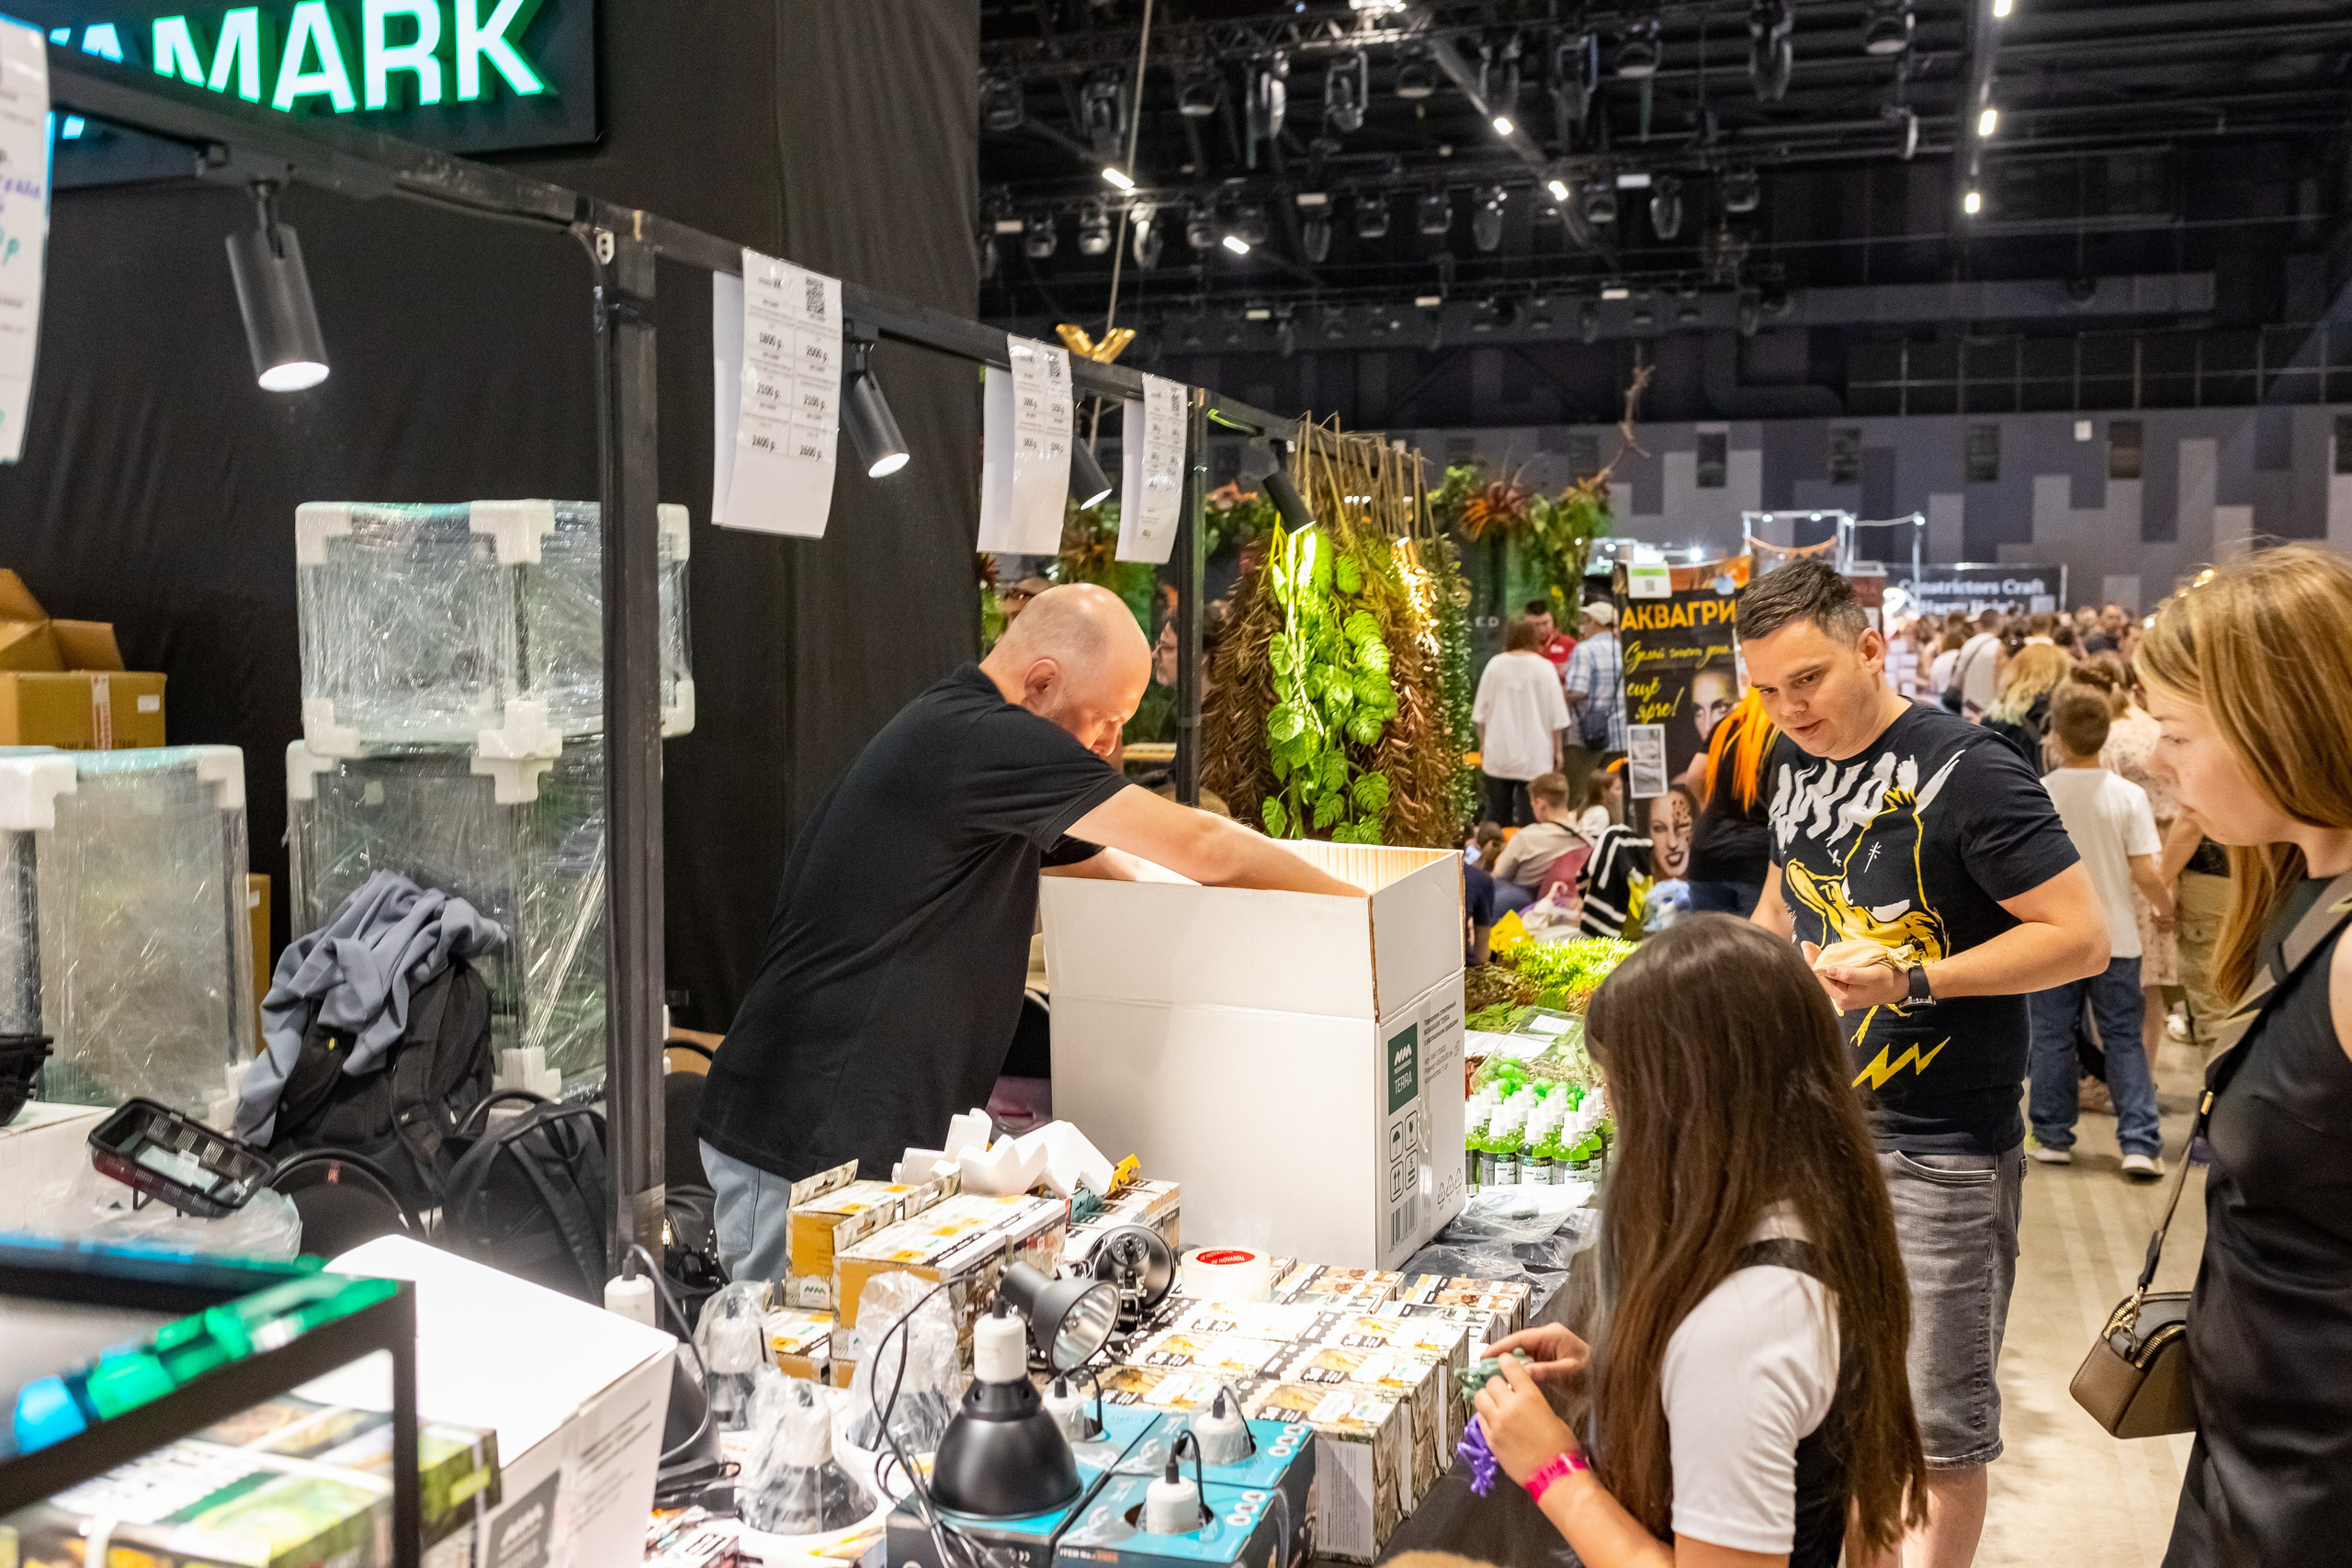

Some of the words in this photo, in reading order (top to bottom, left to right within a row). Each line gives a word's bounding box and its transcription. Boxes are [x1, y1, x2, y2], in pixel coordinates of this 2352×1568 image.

[2001, 578, 2045, 595] Craft
[1621, 599, 1736, 631] АКВАГРИ
[1395, 1070, 1413, 1095] TERRA
